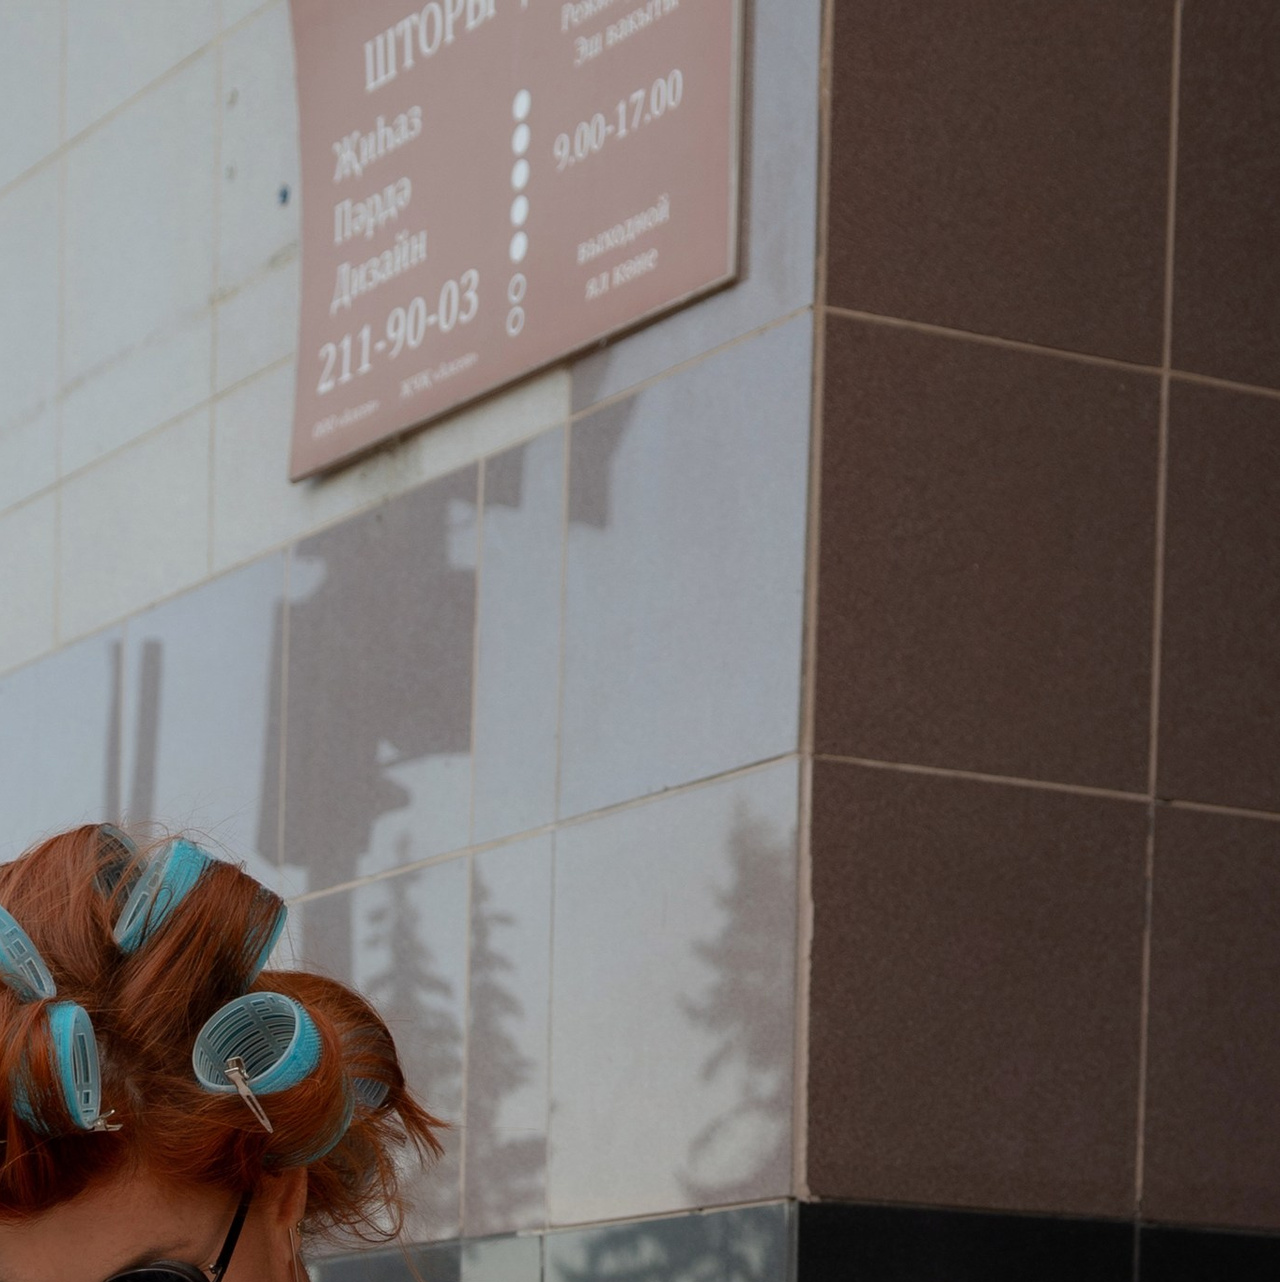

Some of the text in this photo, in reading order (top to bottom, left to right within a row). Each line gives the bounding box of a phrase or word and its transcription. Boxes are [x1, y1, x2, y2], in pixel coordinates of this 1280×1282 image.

[554, 68, 684, 171] 9.00-17.00
[329, 229, 427, 317] Дизайн
[317, 268, 480, 395] 211-90-03
